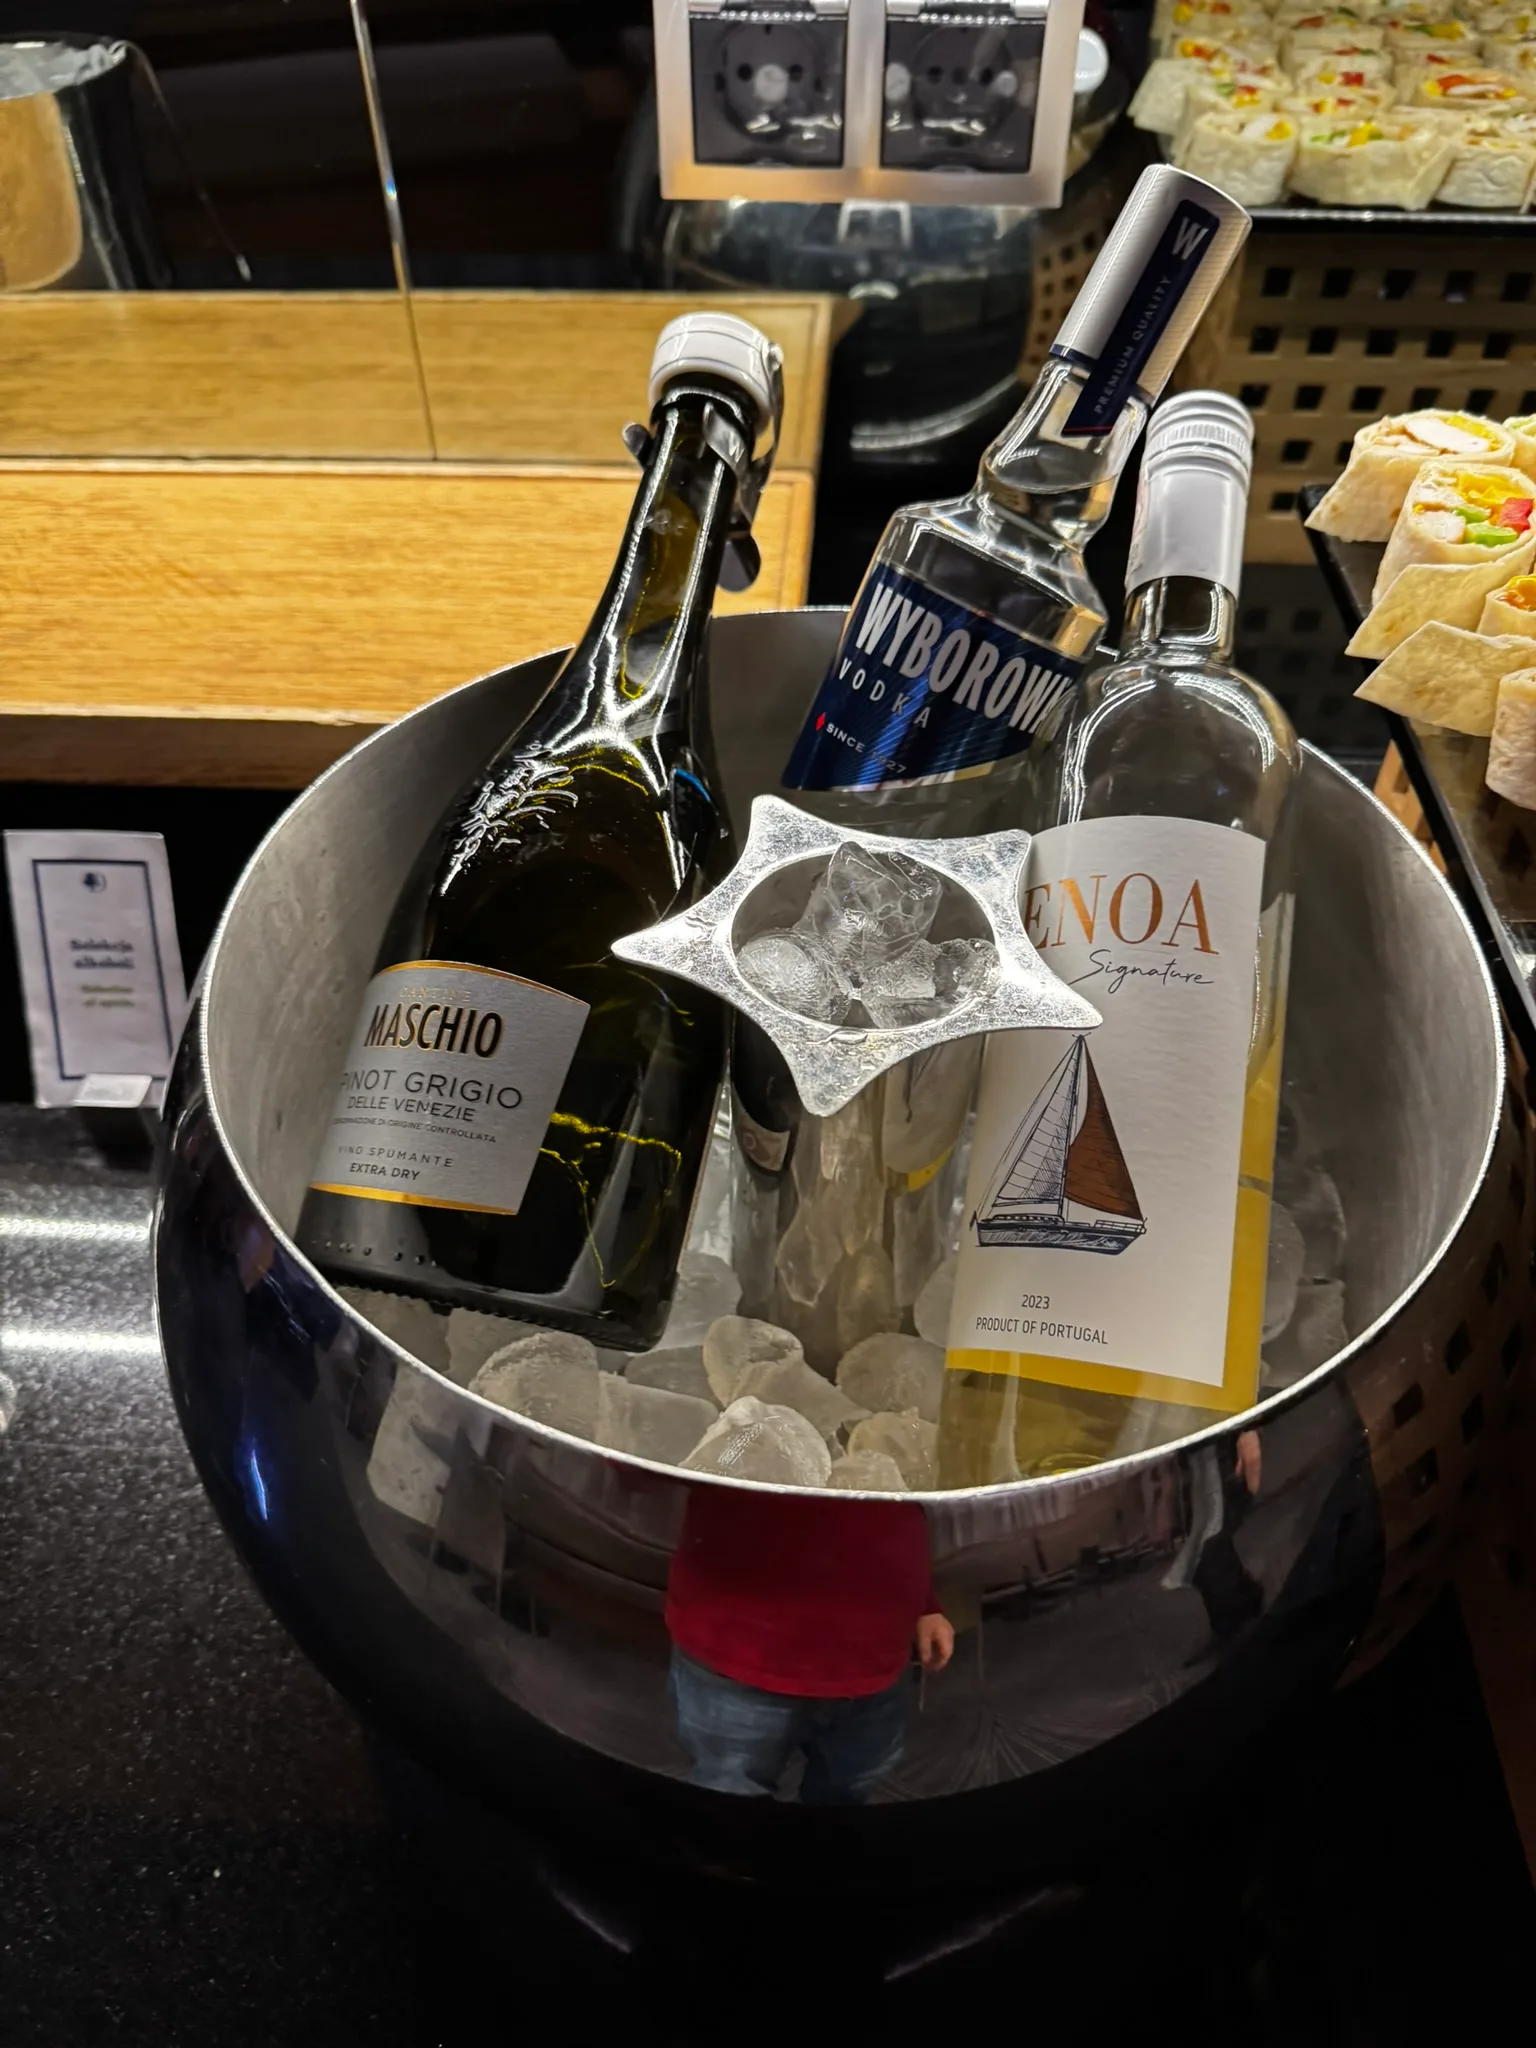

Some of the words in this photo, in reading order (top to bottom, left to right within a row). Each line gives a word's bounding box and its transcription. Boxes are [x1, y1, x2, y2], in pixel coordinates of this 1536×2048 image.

[1172, 217, 1210, 261] W
[1094, 345, 1135, 414] PREMIUM
[1132, 278, 1171, 341] QUALITY
[838, 658, 931, 729] VODKA
[826, 722, 866, 753] SINCE
[1067, 949, 1215, 995] Signature
[363, 1002, 504, 1059] MASCHIO
[404, 1071, 523, 1110] GRIGIO
[347, 1096, 390, 1109] DELLE
[394, 1097, 477, 1122] VENEZIE
[424, 1122, 497, 1144] CONTROLLATA
[349, 1162, 387, 1177] EXTRA
[391, 1166, 421, 1181] DRY
[368, 1146, 455, 1169] SPUMANTE
[1020, 1293, 1051, 1311] 2023
[975, 1316, 1020, 1334] PRODUCT
[1022, 1319, 1037, 1334] OF
[1040, 1321, 1109, 1345] PORTUGAL
